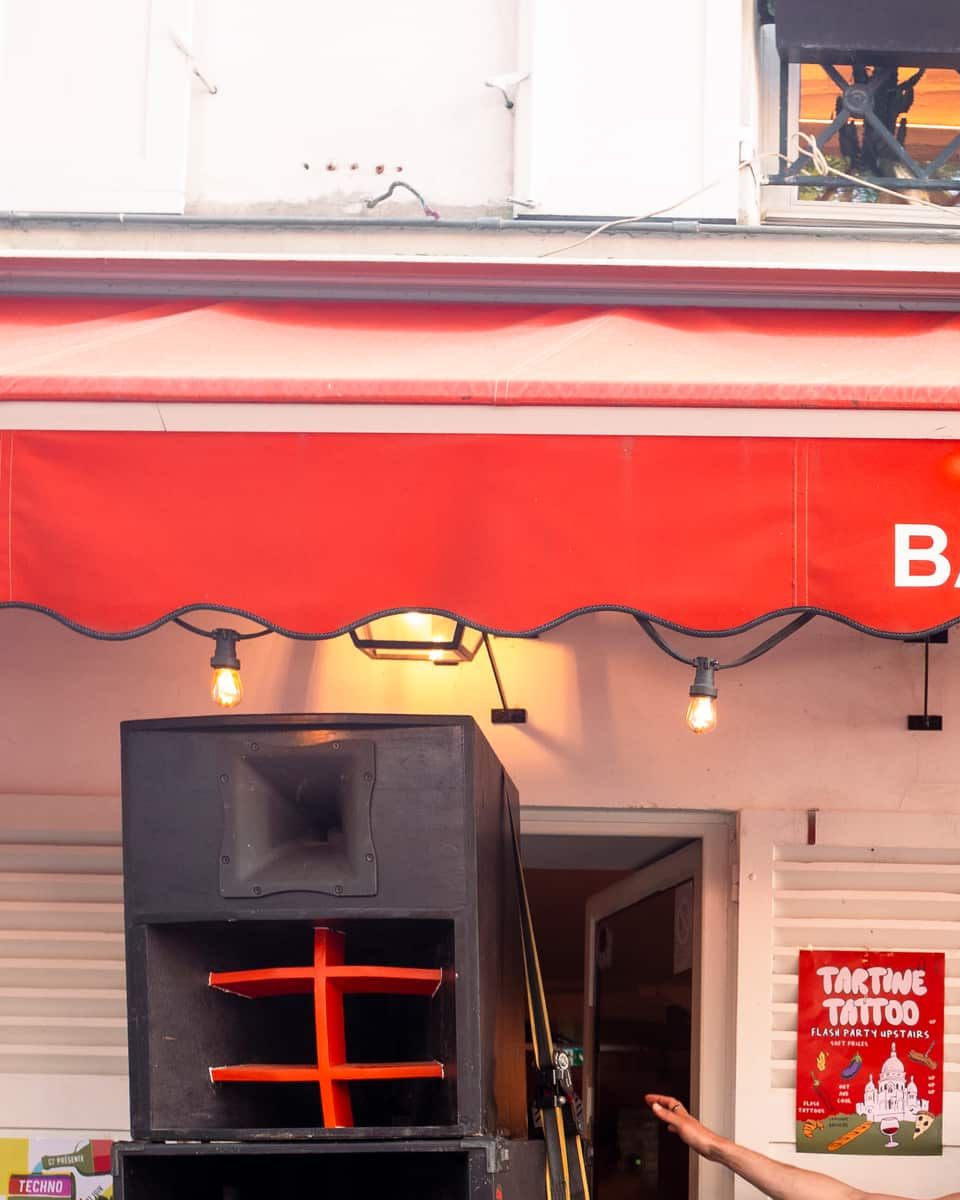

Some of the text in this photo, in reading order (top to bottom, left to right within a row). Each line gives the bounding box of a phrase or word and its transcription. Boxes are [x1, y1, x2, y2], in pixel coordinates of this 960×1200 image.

[816, 966, 928, 996] TARTINE
[822, 998, 920, 1026] TATTOO
[811, 1027, 930, 1039] FLASH PARTY UPSTAIRS
[19, 1180, 63, 1193] TECHNO
